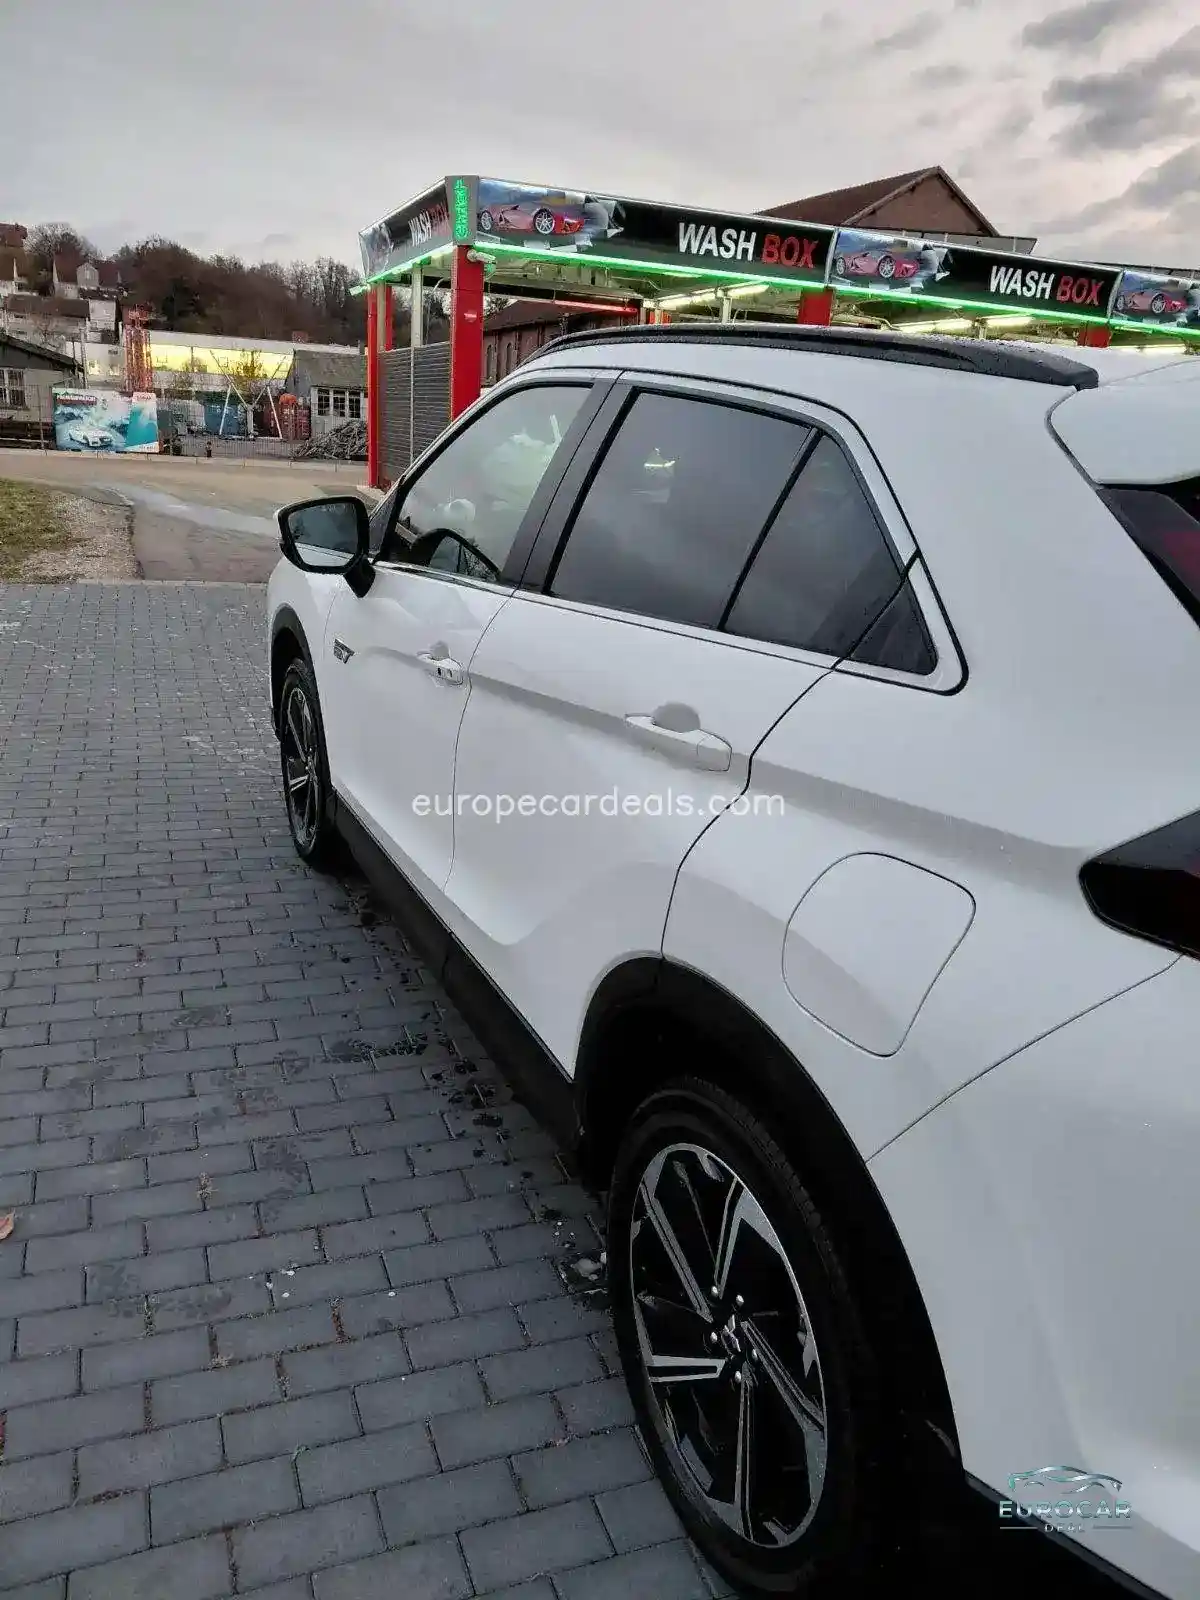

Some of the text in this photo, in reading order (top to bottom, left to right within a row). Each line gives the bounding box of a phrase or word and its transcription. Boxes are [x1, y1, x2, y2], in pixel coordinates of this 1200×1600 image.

[407, 211, 432, 247] WASH
[678, 222, 820, 269] WASH BOX
[989, 265, 1105, 307] WASH BOX
